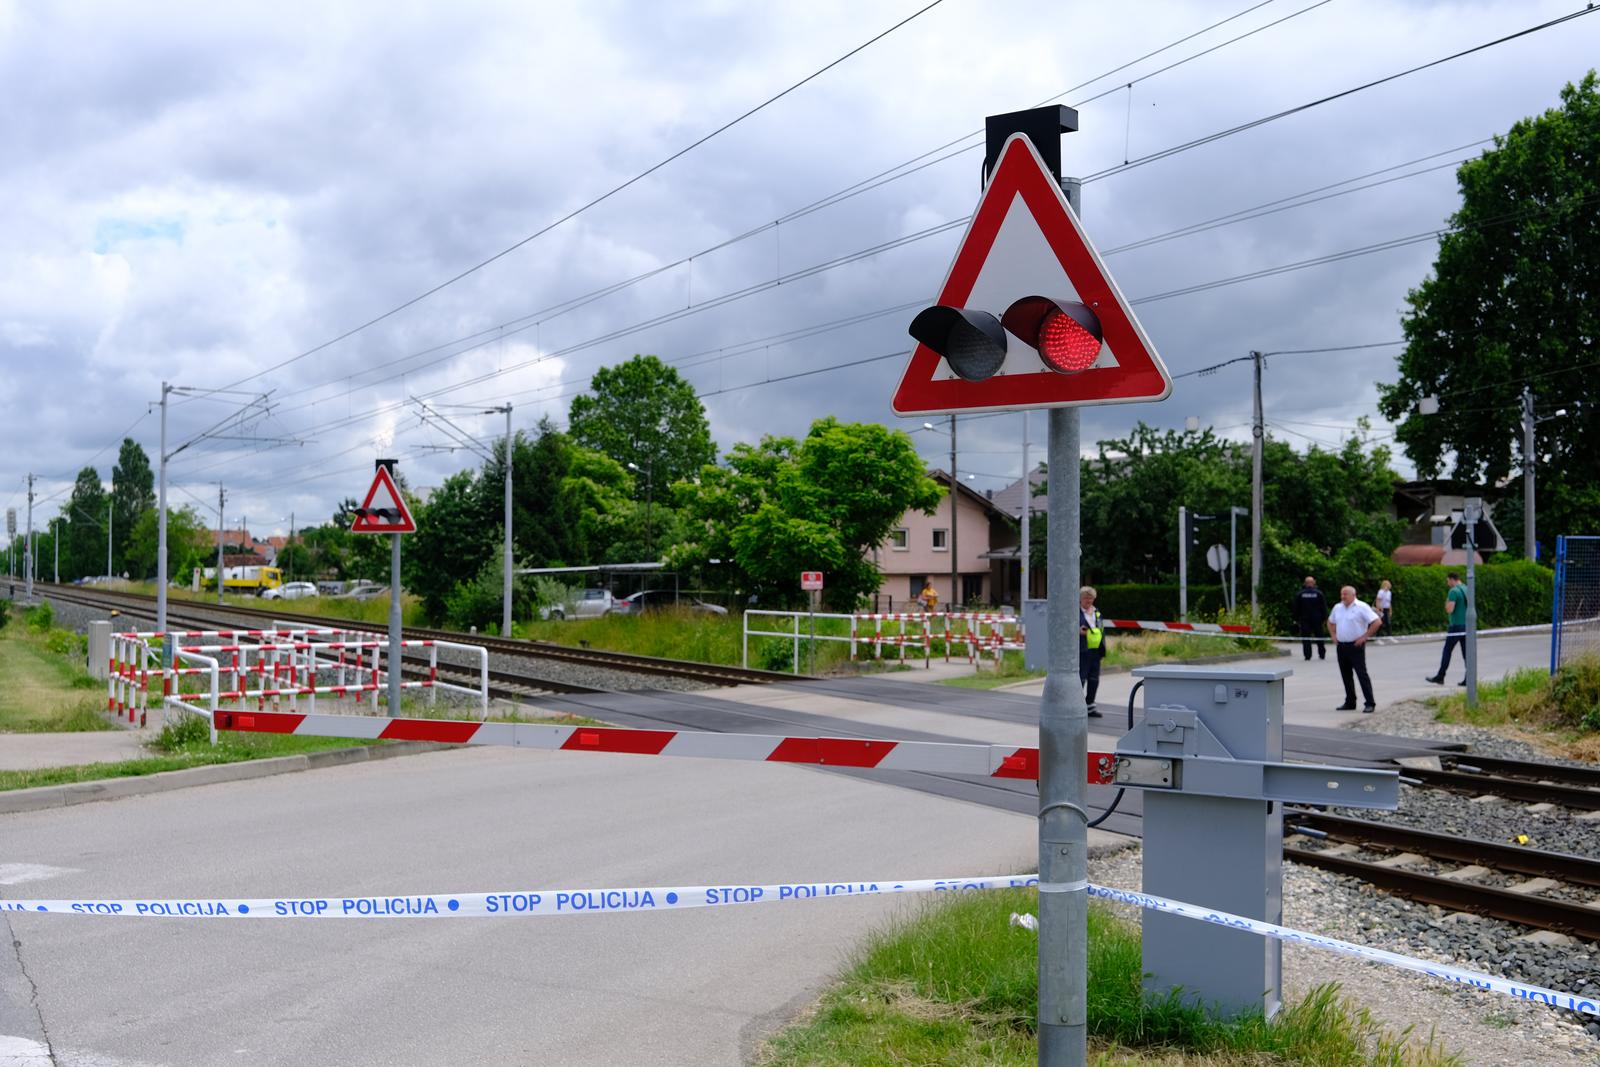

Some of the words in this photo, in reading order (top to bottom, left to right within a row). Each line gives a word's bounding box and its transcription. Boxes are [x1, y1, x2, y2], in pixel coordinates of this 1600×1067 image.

[71, 903, 123, 914] STOP
[136, 902, 230, 916] POLICIJA
[275, 900, 328, 915] STOP
[342, 897, 439, 915] POLICIJA
[485, 894, 542, 913] STOP
[556, 890, 656, 911] POLICIJA
[706, 886, 764, 904] STOP
